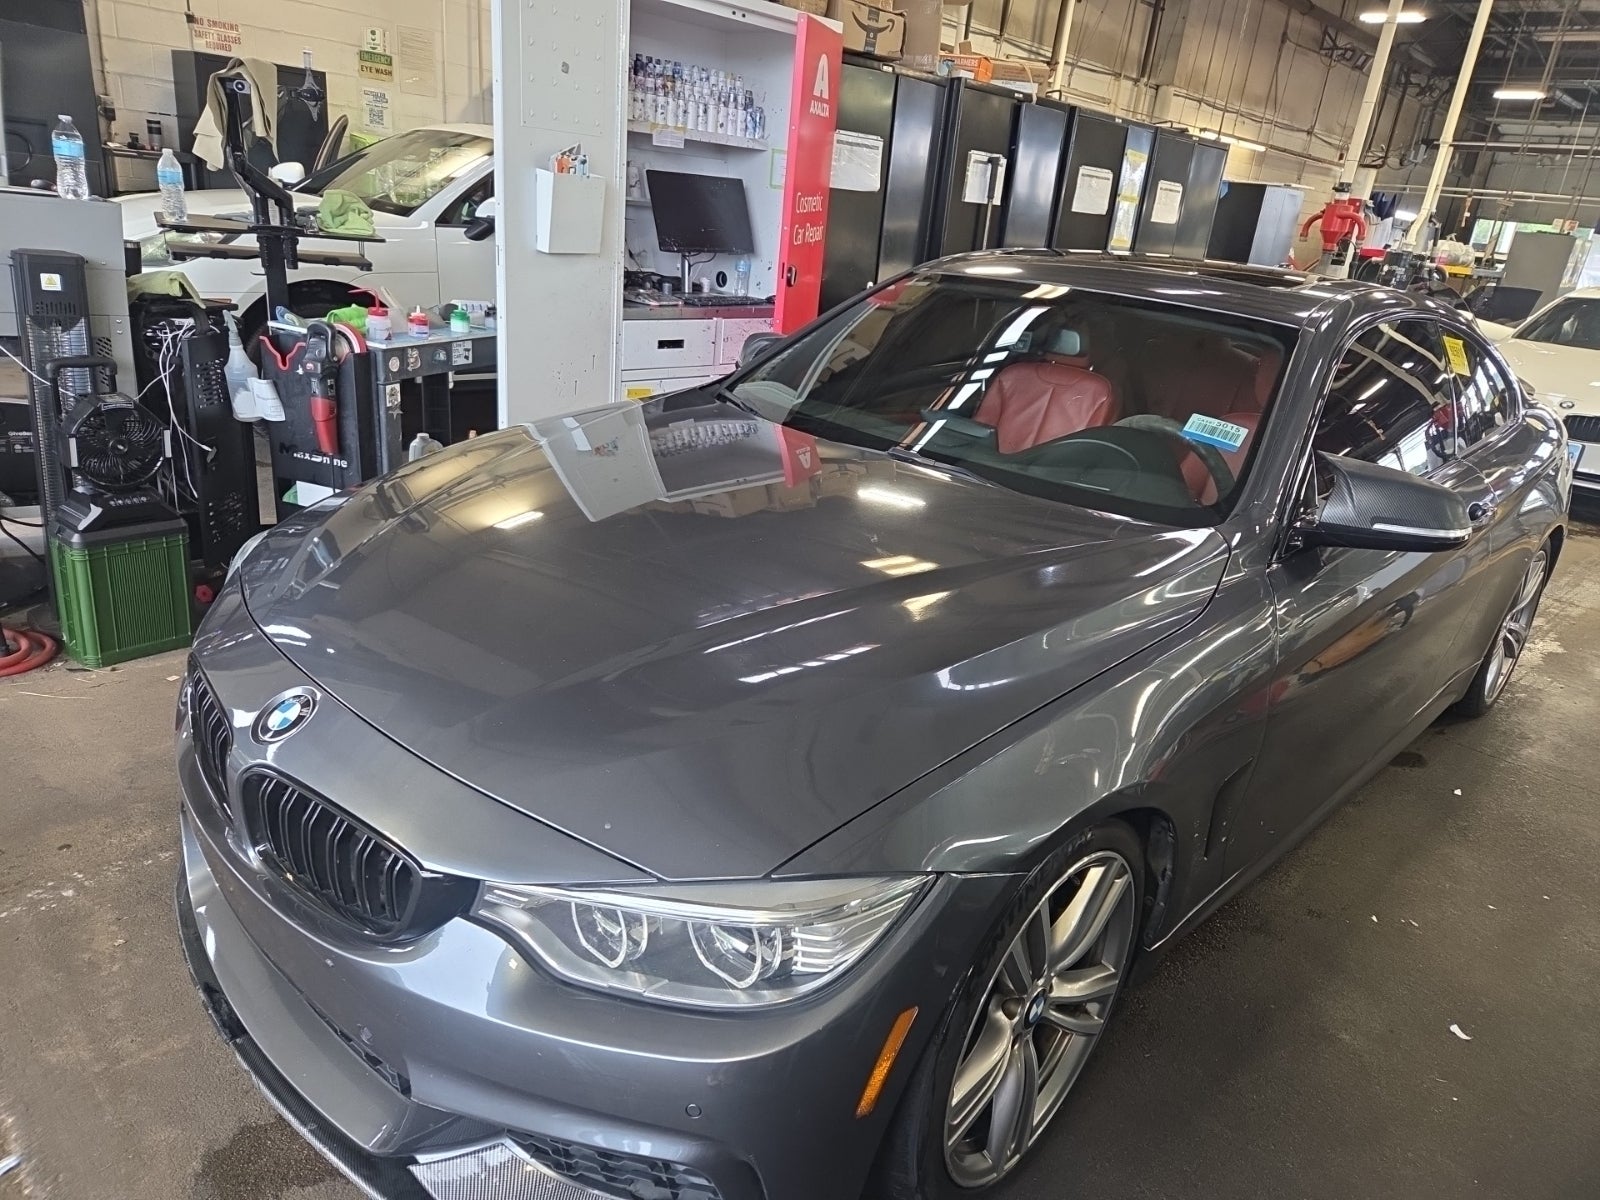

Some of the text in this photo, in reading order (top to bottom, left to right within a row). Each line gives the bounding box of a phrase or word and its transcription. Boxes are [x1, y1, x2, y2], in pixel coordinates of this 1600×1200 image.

[194, 17, 240, 32] NO SMOKING
[194, 30, 242, 45] SAFETY GLASSES
[205, 40, 232, 52] REQUIRED
[361, 51, 391, 65] EMERGENCY
[361, 65, 392, 76] EYE WASH
[810, 99, 830, 118] AXALTA
[796, 192, 823, 213] Cosmetic
[793, 221, 824, 246] Car Repair
[1215, 421, 1242, 433] 5015
